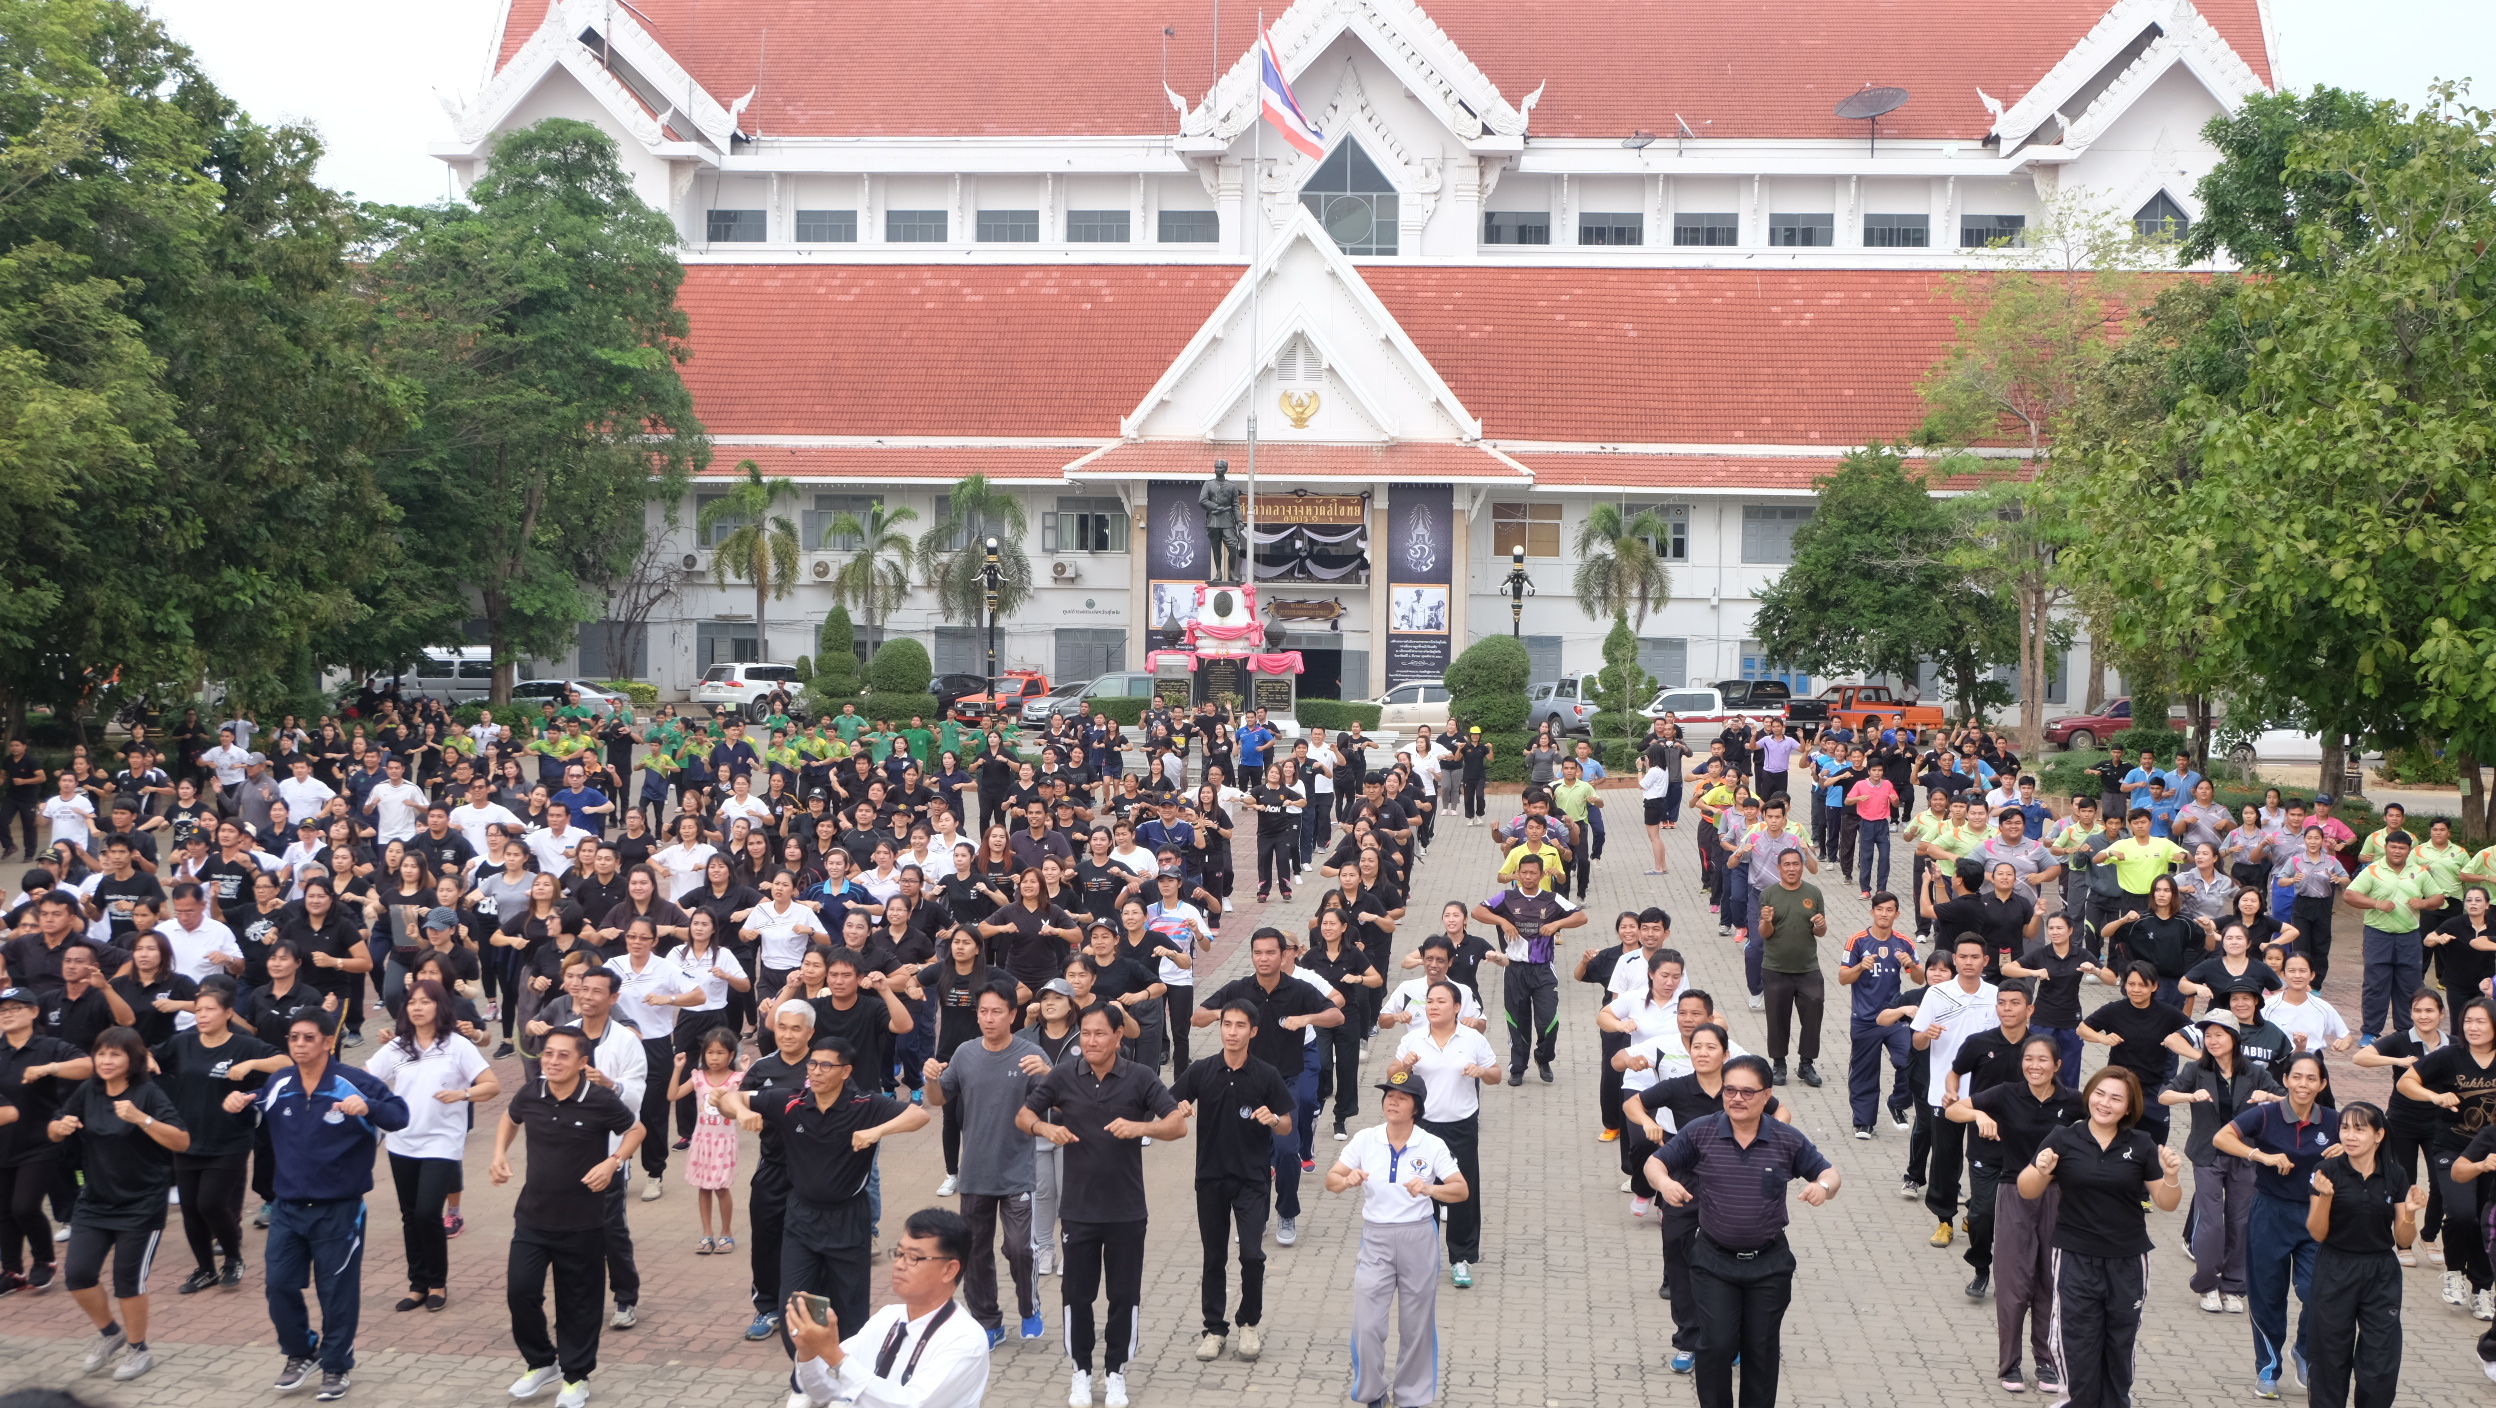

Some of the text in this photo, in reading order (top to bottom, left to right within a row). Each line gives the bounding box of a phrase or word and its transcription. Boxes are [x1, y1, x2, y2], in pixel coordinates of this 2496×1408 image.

[1240, 498, 1361, 522] ศลากลางจังหวัดสุโขทัย
[456, 797, 466, 807] 37
